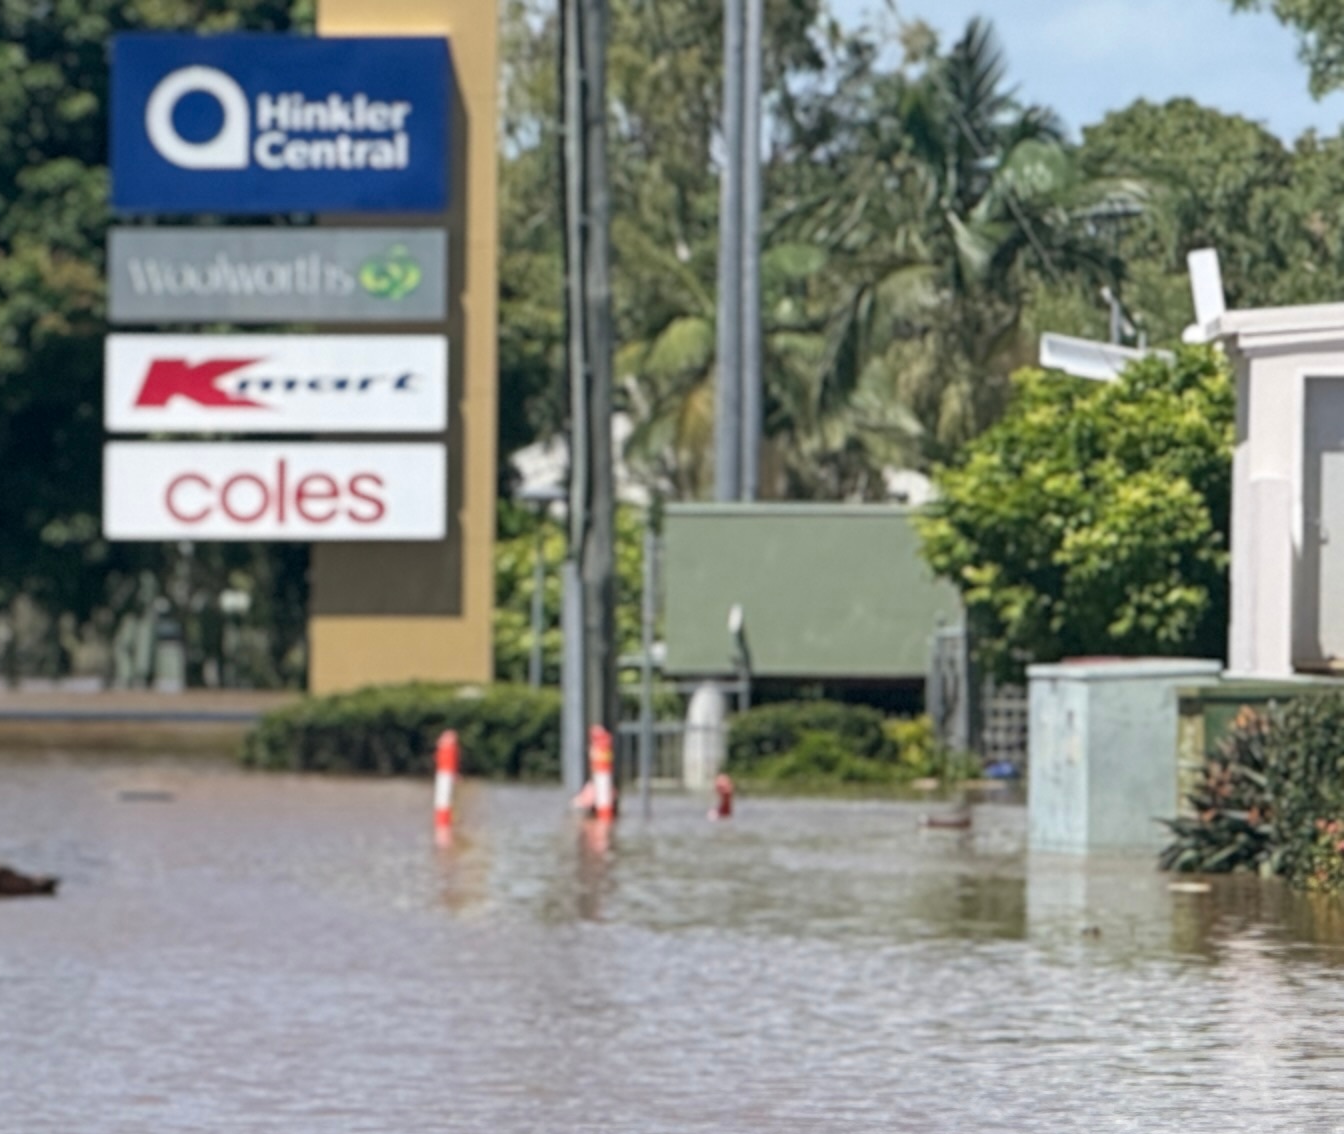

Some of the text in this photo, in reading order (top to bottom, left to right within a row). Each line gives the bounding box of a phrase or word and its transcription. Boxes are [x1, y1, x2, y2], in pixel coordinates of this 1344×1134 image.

[256, 94, 411, 131] Hinkler
[254, 132, 409, 170] Central
[127, 252, 354, 297] Woolworths
[164, 457, 387, 525] coles
